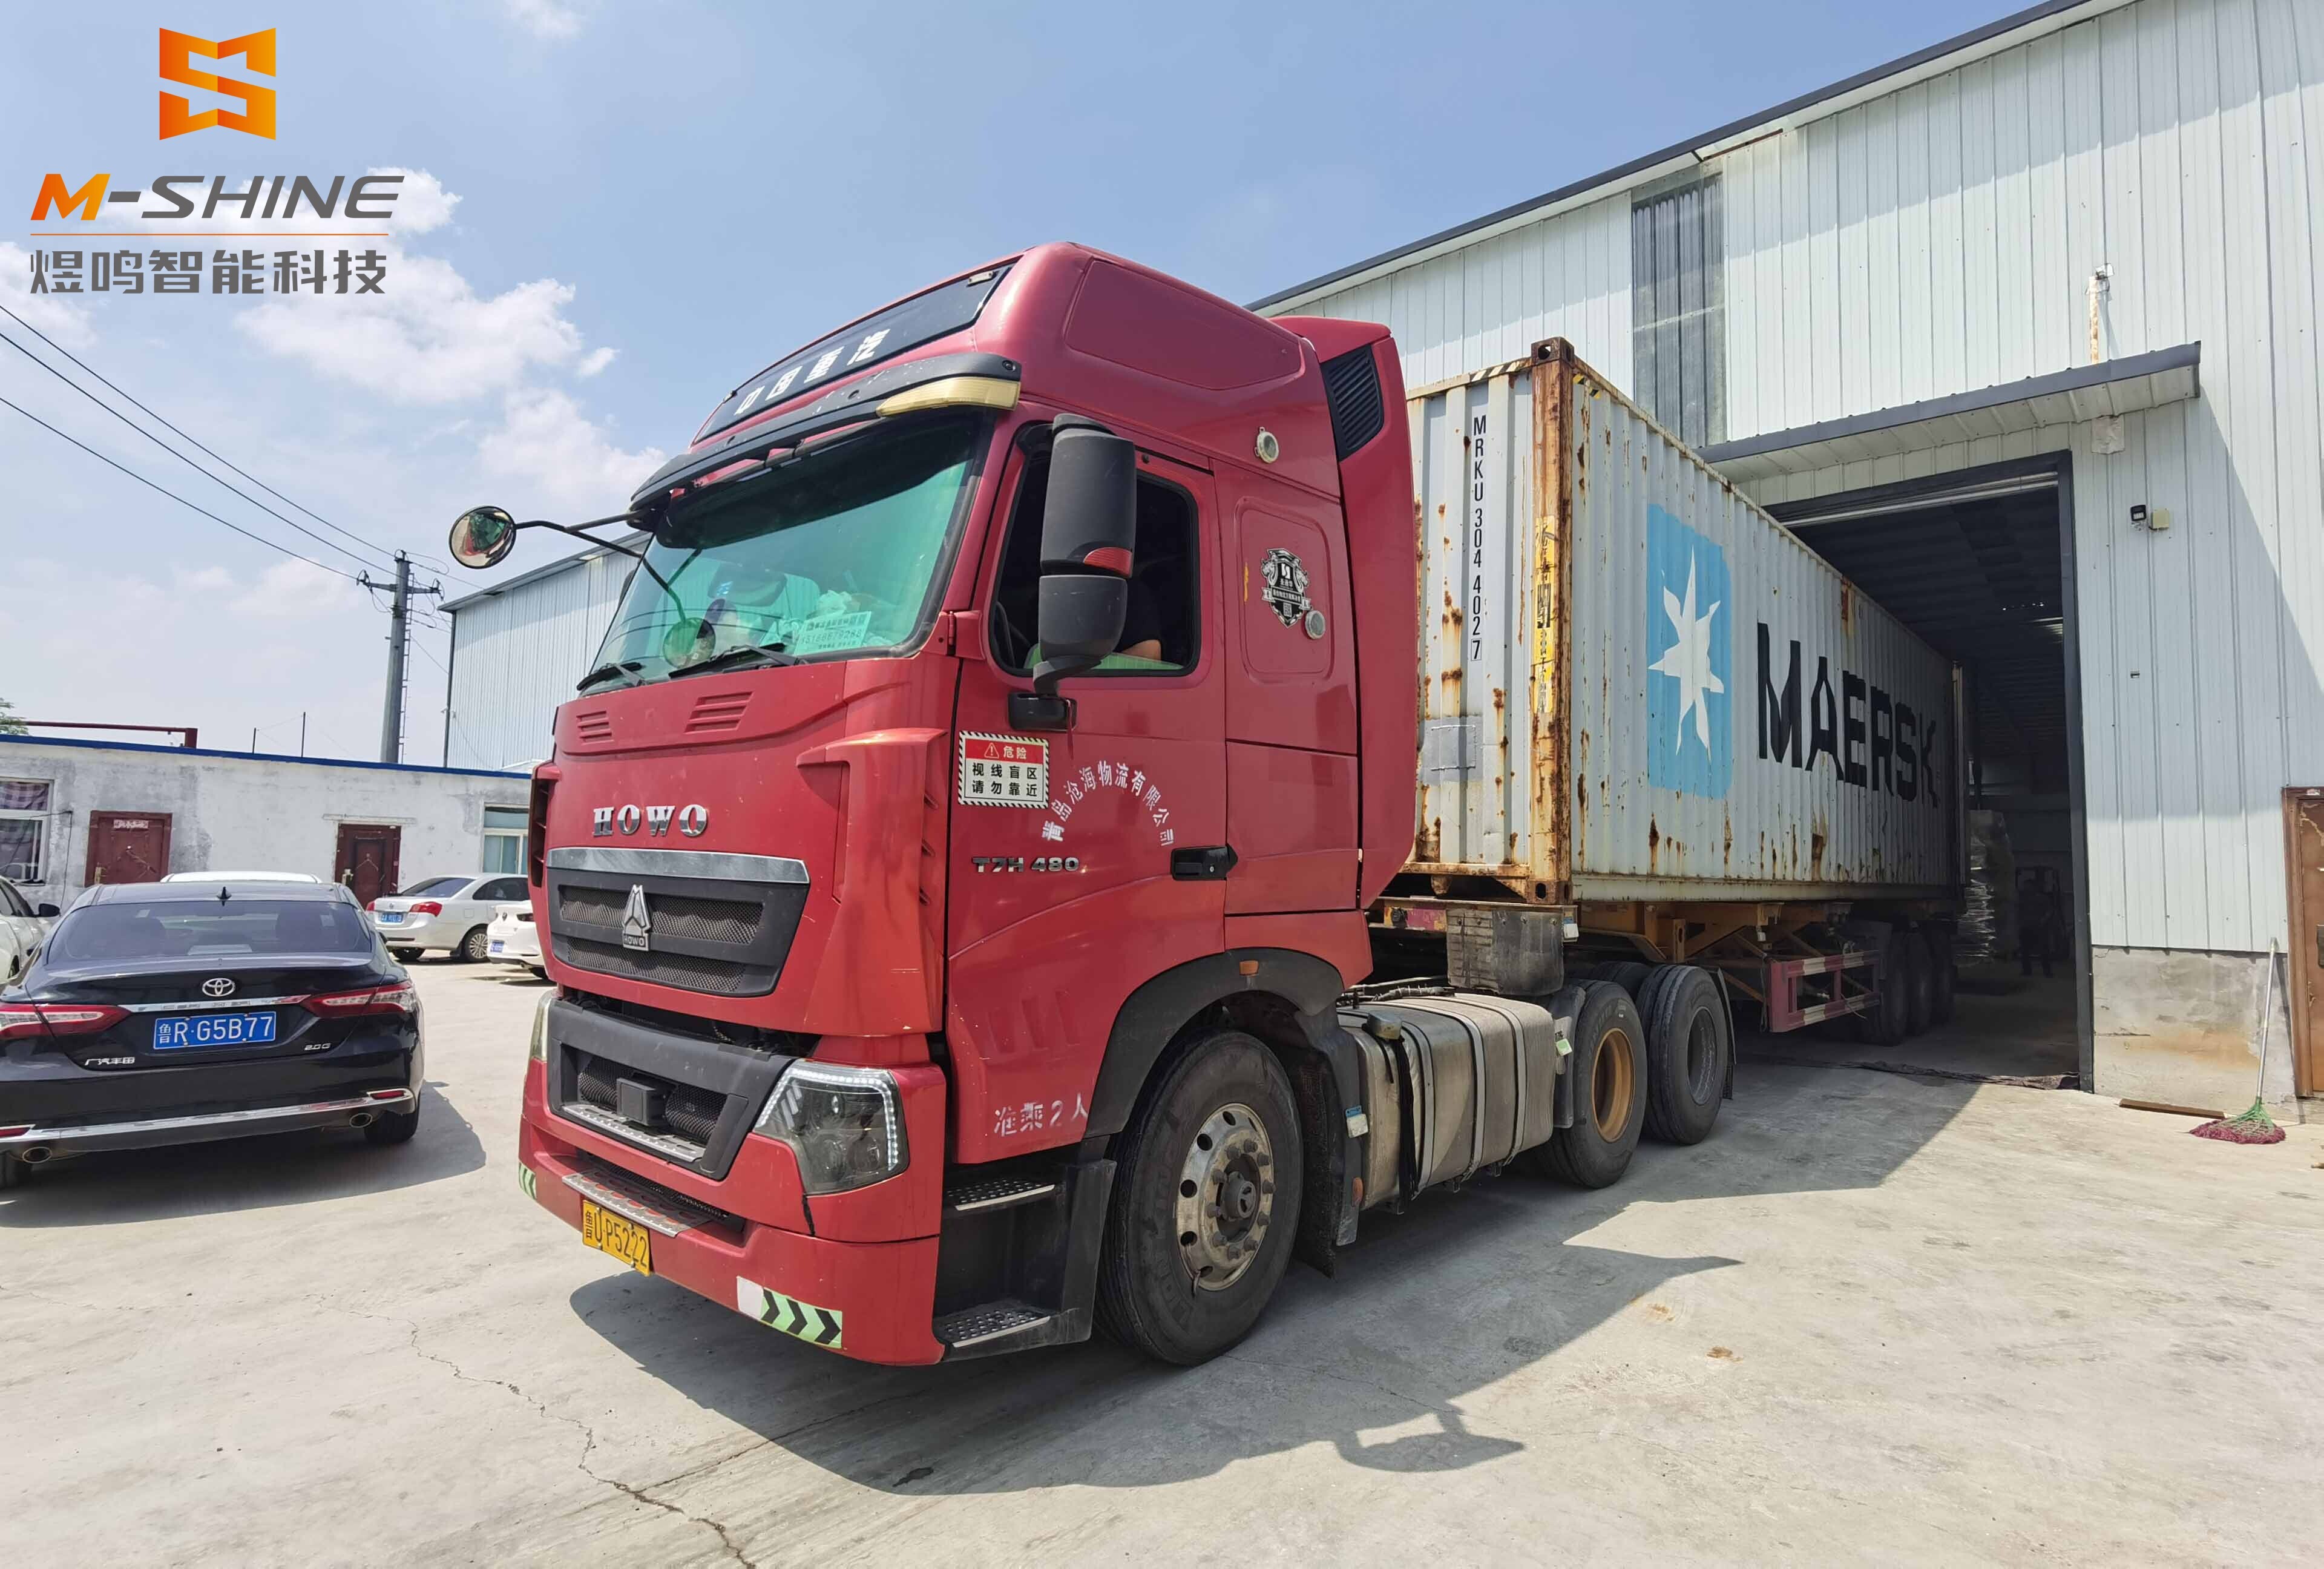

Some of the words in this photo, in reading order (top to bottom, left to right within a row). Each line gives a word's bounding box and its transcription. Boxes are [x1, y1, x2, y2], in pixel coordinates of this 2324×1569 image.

[1473, 415, 1486, 501] MRKU
[1757, 622, 1937, 809] MAERSK
[1003, 745, 1027, 759] 危险
[972, 762, 1037, 780] 视线盲区
[972, 780, 1037, 797] 请勿靠近
[592, 804, 708, 837] HOWO
[972, 857, 1024, 873] T7H
[1031, 857, 1080, 872] 480
[623, 935, 645, 947] HOWO
[85, 1057, 135, 1066] 广汽丰田
